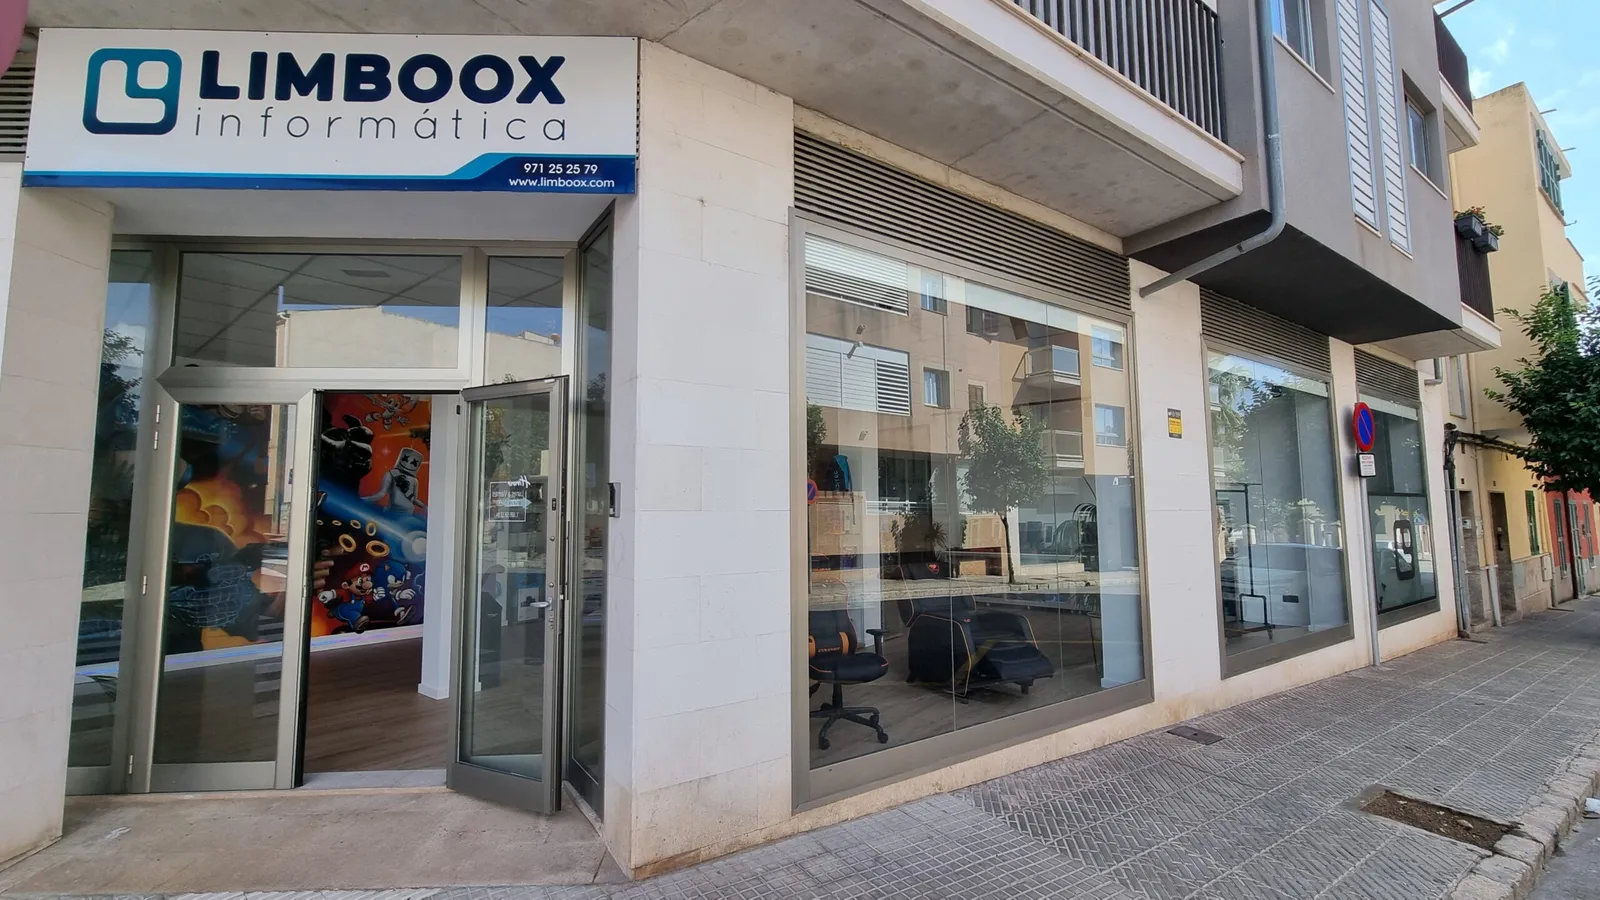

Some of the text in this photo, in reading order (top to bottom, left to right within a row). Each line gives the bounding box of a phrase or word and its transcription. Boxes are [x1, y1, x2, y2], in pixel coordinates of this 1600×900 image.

[199, 50, 566, 105] LIMBOOX
[195, 106, 566, 141] informática
[524, 163, 598, 174] 971 25 25 79
[509, 177, 614, 187] www.limboox.com
